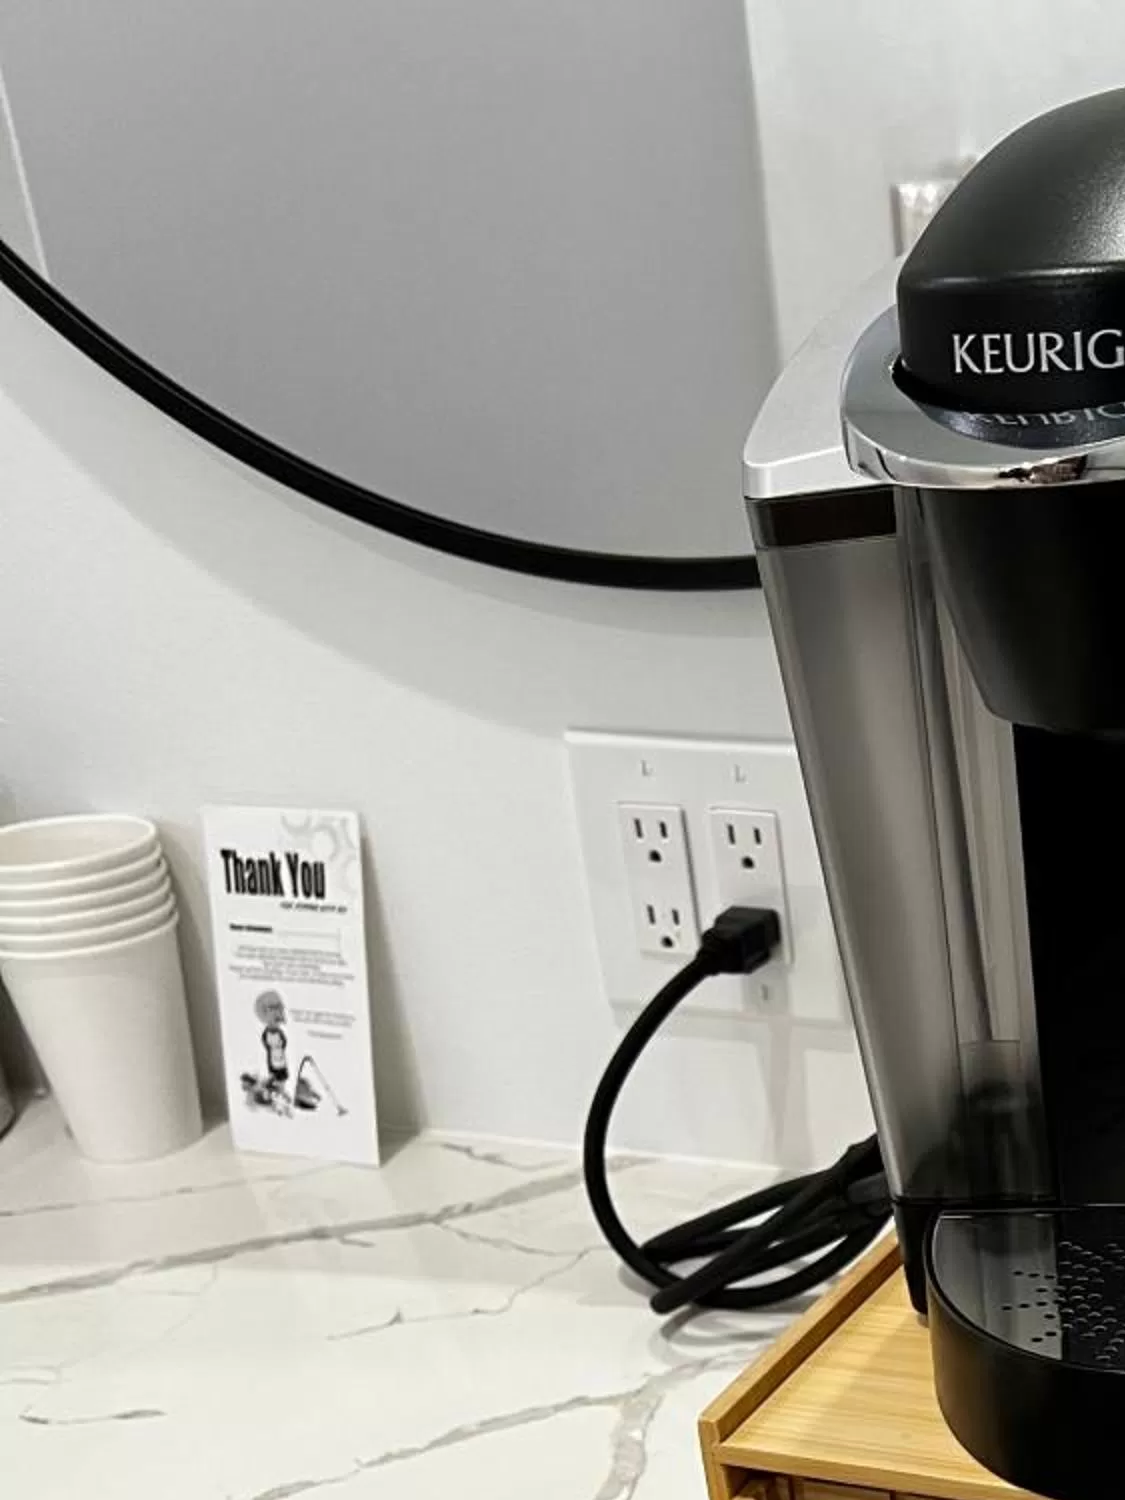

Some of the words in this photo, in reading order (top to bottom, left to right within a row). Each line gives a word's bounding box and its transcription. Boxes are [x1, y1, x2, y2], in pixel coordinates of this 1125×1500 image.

[952, 329, 1125, 374] KEURIG
[220, 848, 285, 897] Thank
[285, 851, 327, 900] You
